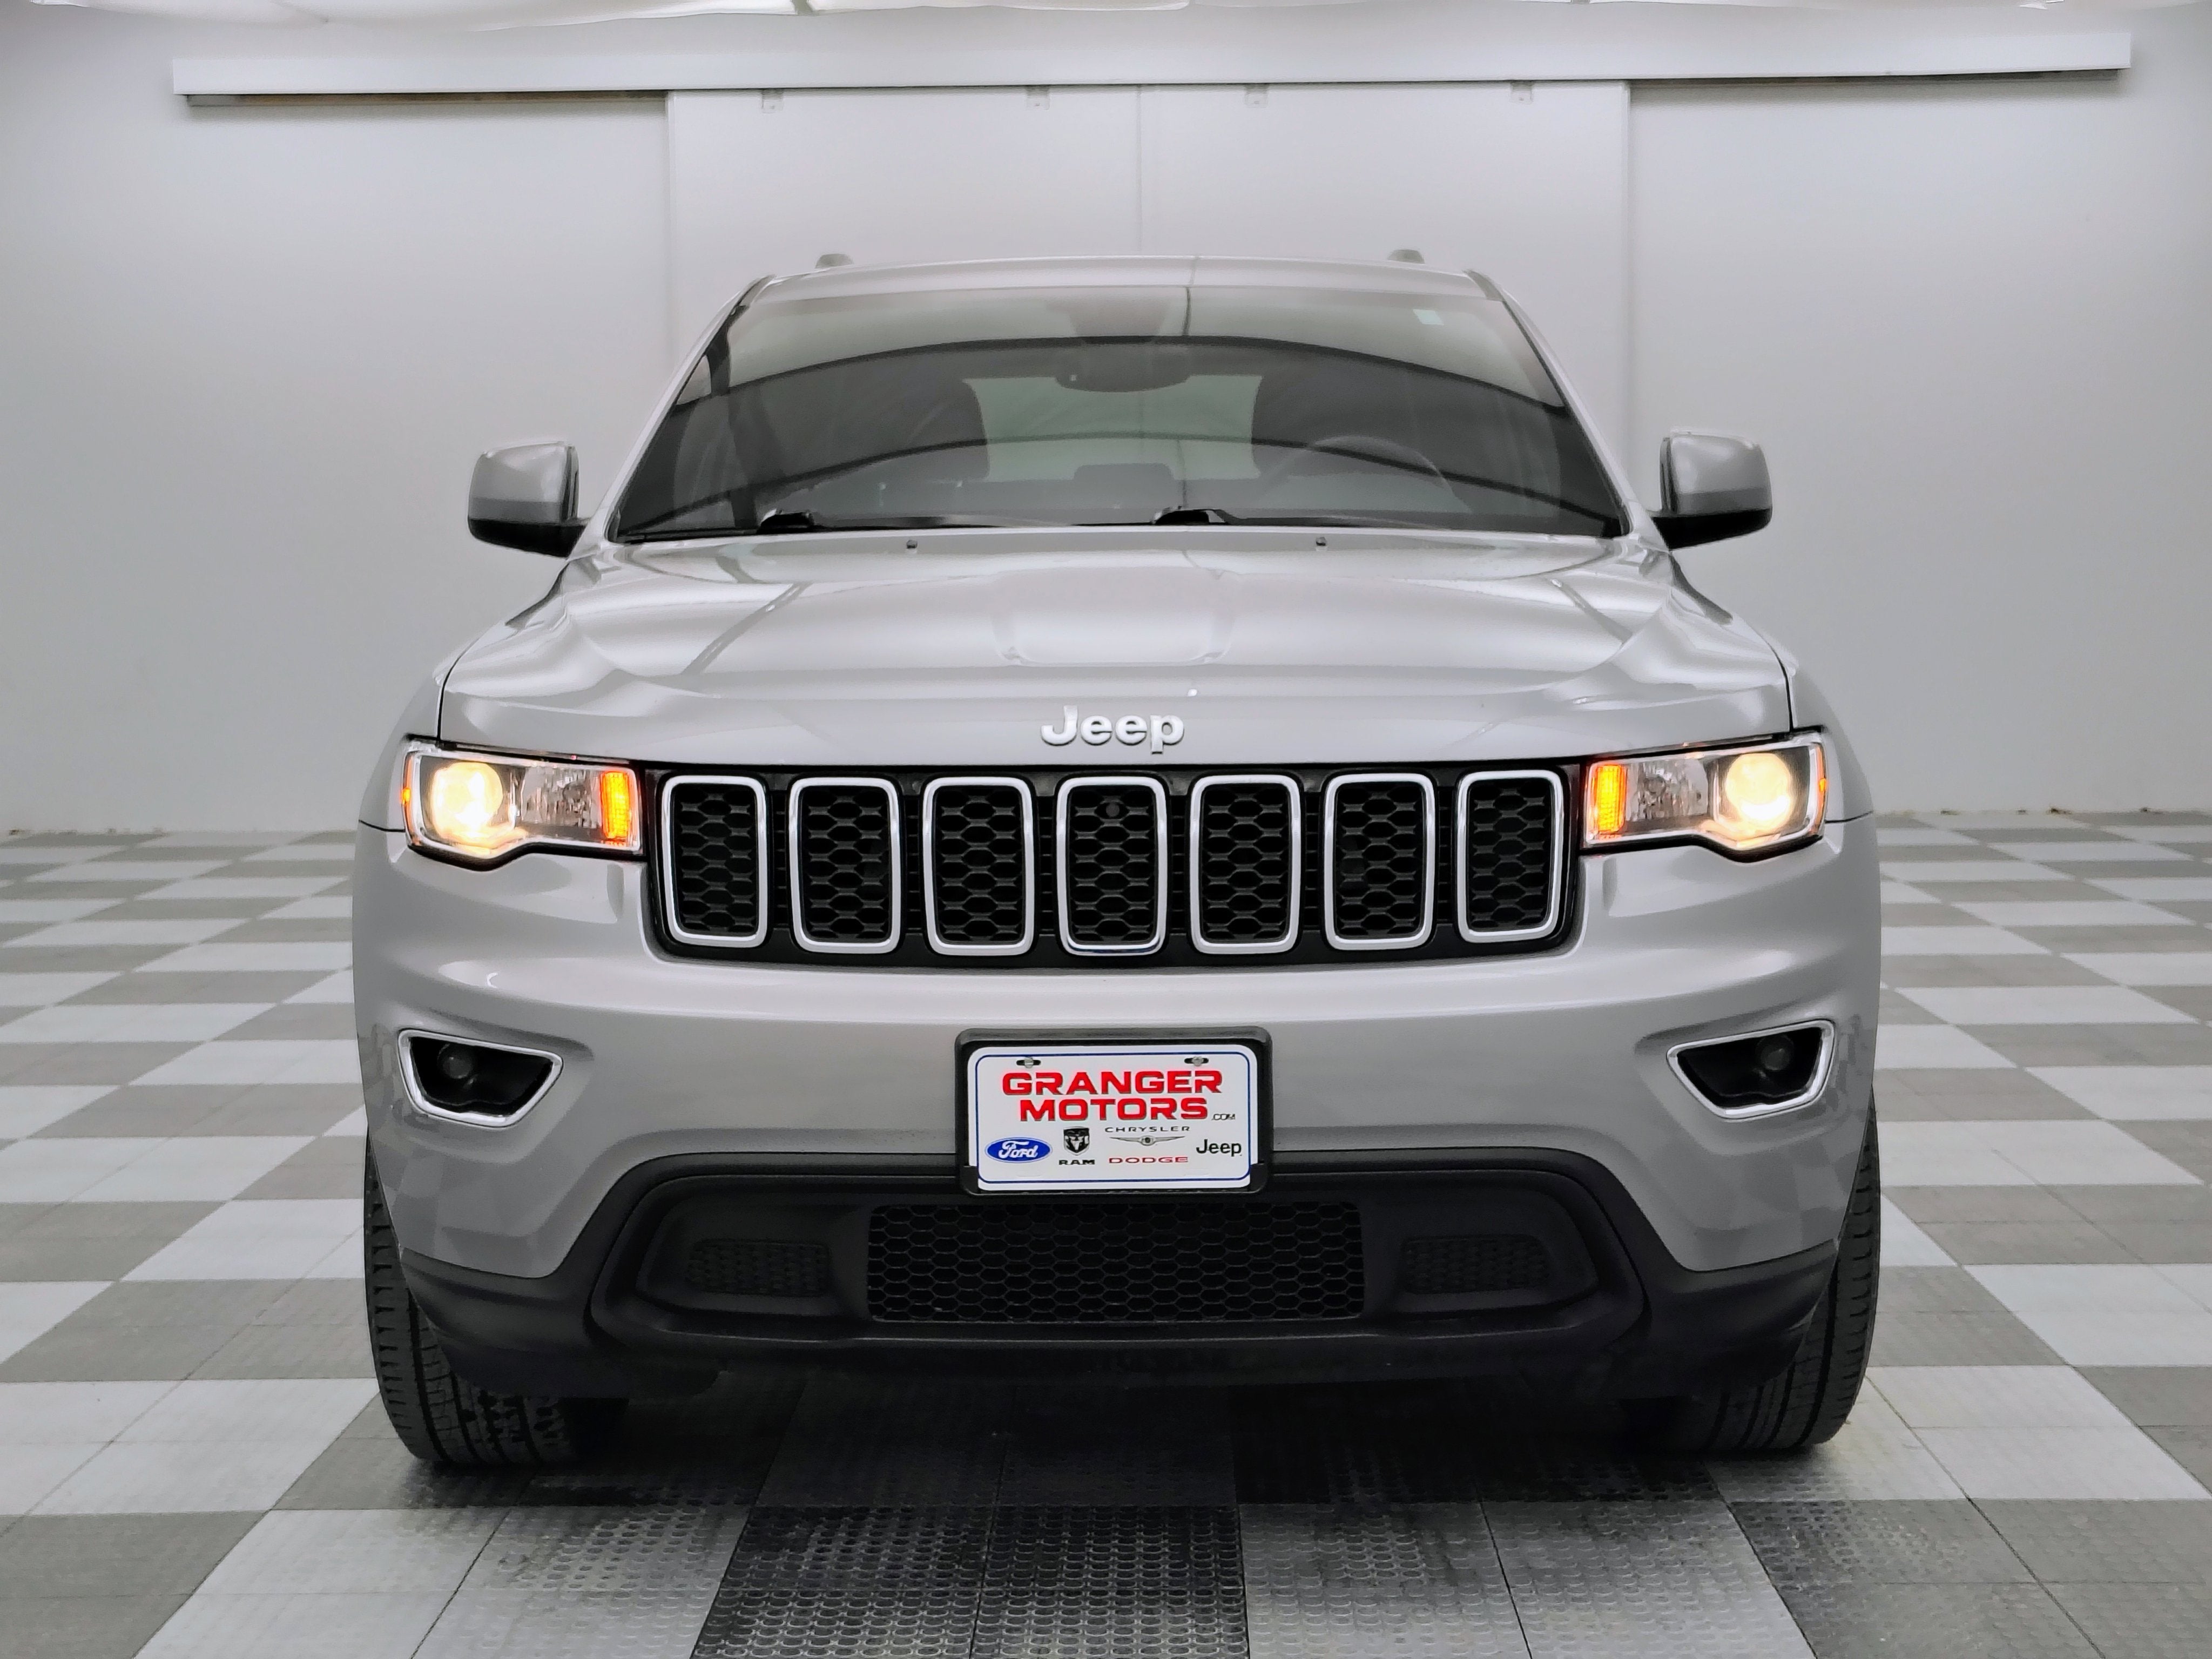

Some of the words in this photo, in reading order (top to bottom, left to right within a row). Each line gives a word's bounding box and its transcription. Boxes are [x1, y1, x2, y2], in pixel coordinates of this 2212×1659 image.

[1041, 705, 1184, 754] Jeep
[1002, 1070, 1223, 1096] GRANGER
[1020, 1097, 1208, 1122] MOTORS
[998, 1141, 1038, 1160] Ford
[1196, 1138, 1242, 1157] Jeep
